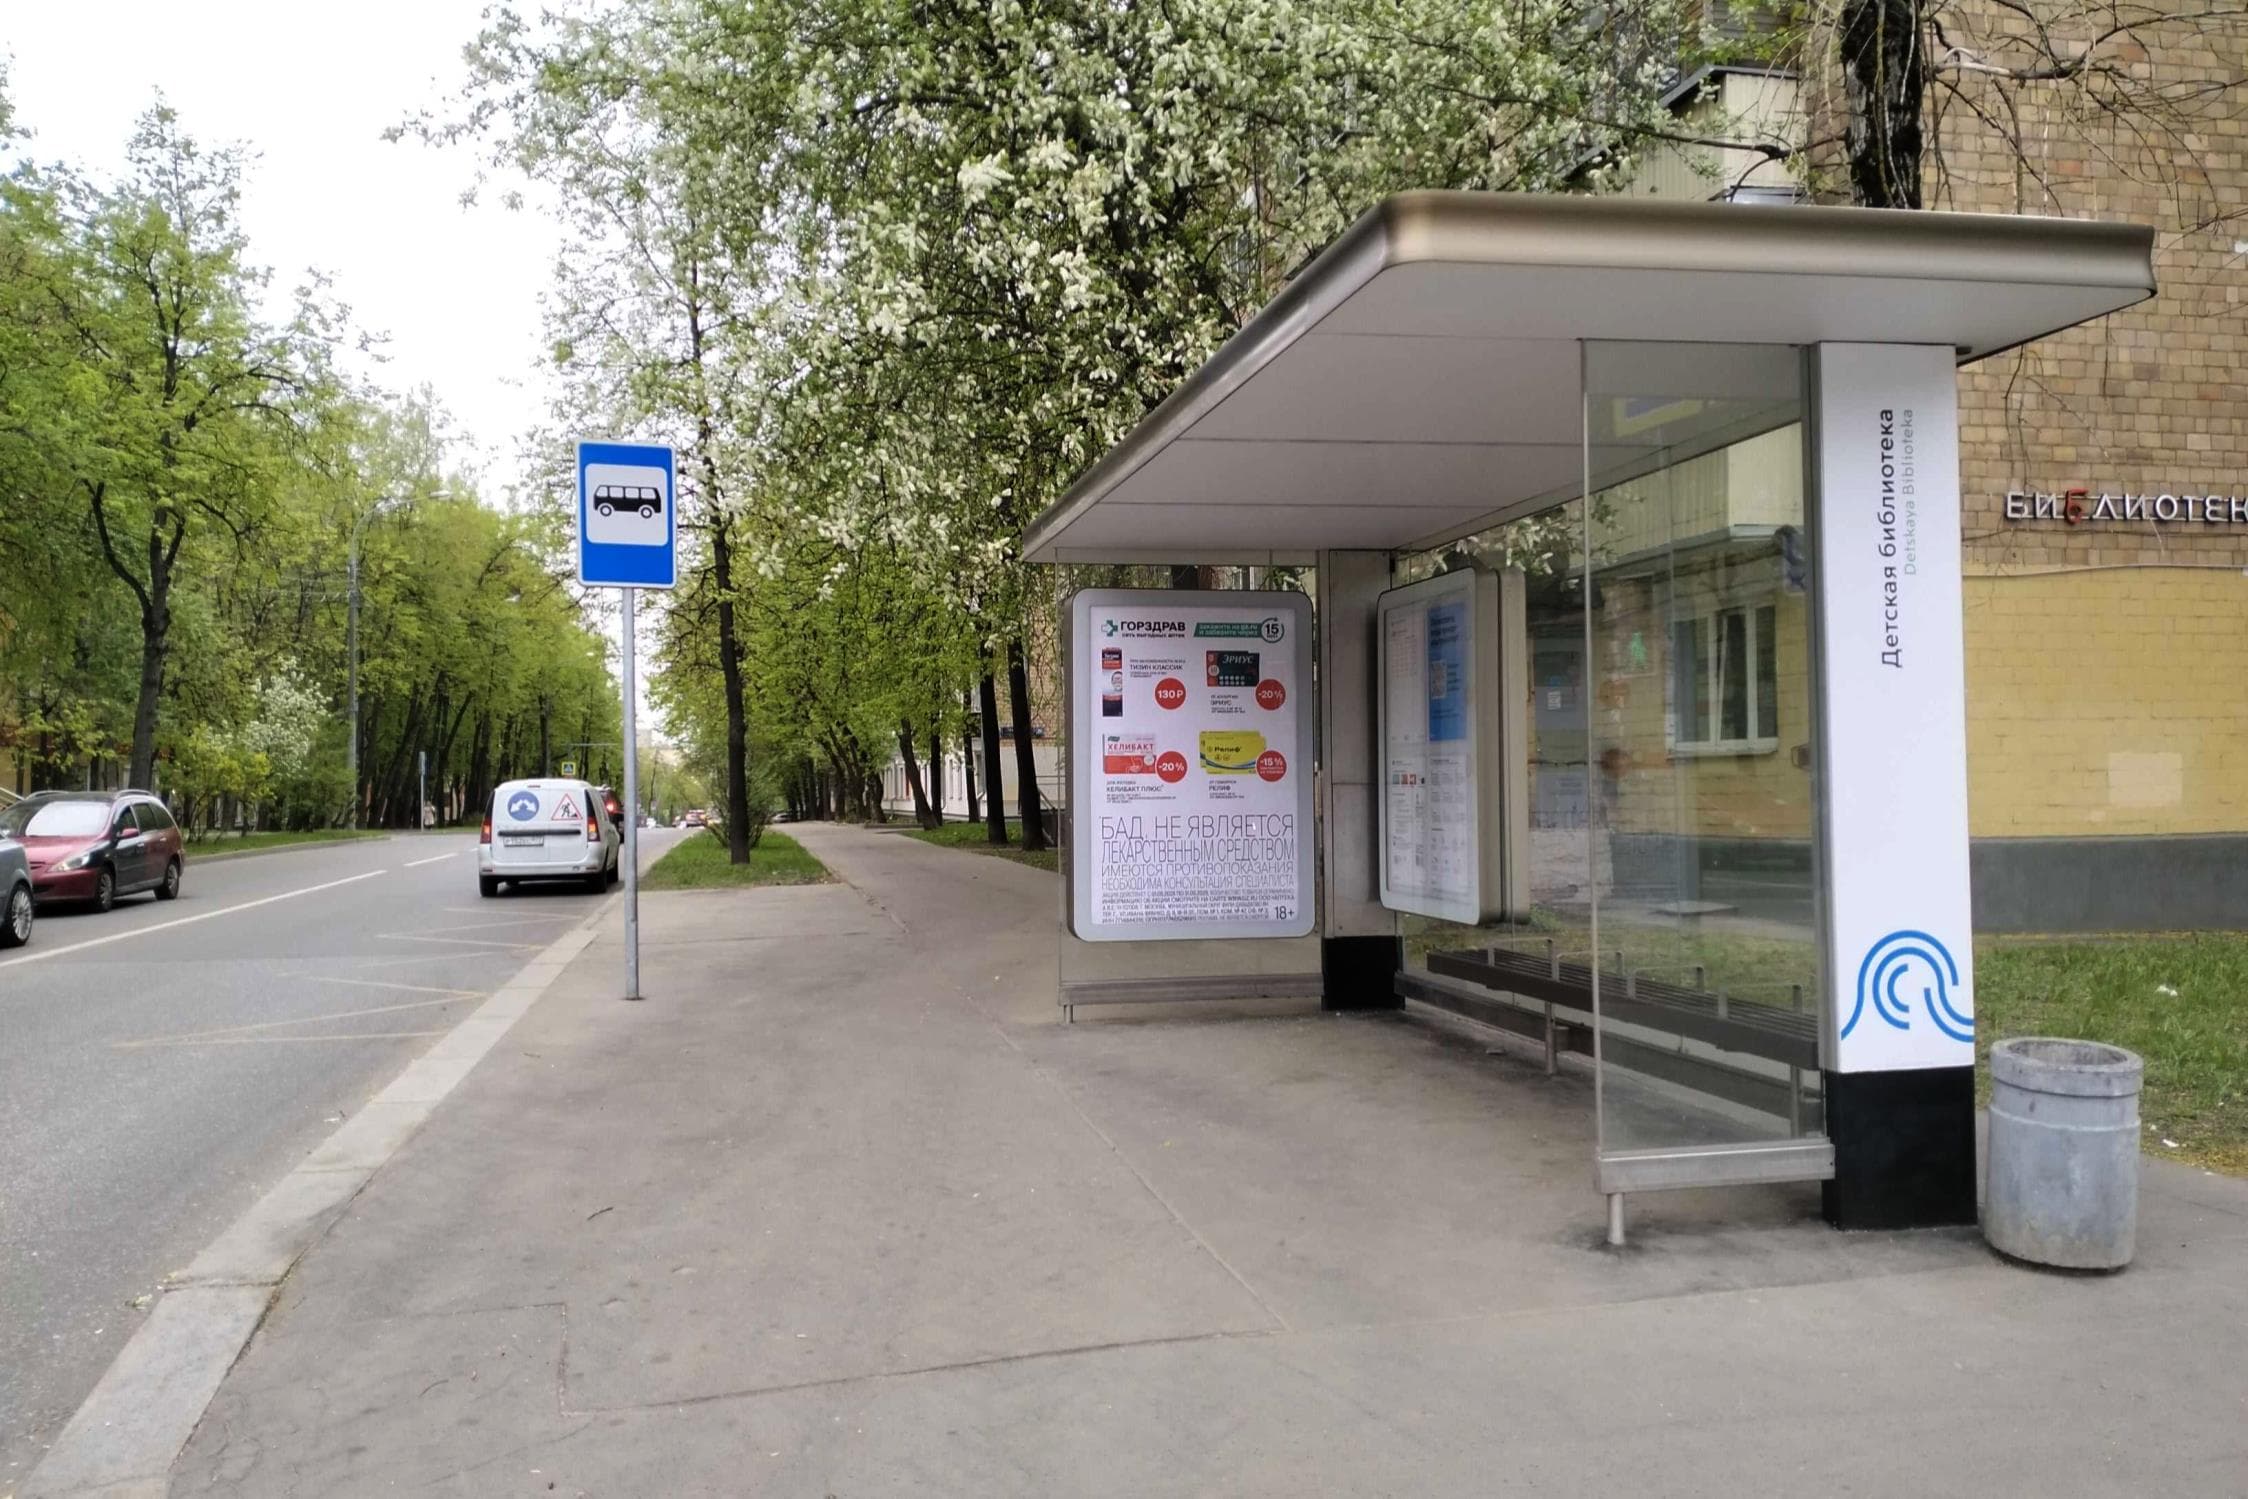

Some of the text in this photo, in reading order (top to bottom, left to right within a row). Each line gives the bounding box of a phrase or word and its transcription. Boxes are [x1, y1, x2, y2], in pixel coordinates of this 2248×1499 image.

[1900, 409, 1917, 575] Detskaya Biblioteka
[1877, 409, 1903, 668] Детская библиотека
[1120, 620, 1186, 633] ГОРЗДРАВ
[1265, 624, 1279, 634] 15
[1222, 654, 1254, 664] ЭРИУС
[1107, 743, 1154, 751] ХЕЛИБАКТ
[1155, 815, 1182, 839] НЕ
[1187, 813, 1294, 838] ЯВЛЯЕТСЯ
[1102, 837, 1294, 864] ЛЕКАРСТВЕННЫМ СРЕДСТВОМ
[1102, 861, 1294, 877] ИМЕЮТСЯ ПРОТИВОПОКАЗАНИЯ
[1102, 873, 1294, 890] НЕОБХОДИМА КОНСУЛЬТАЦИЯ СПЕЦИАЛИСТА
[1274, 905, 1295, 920] 18+
